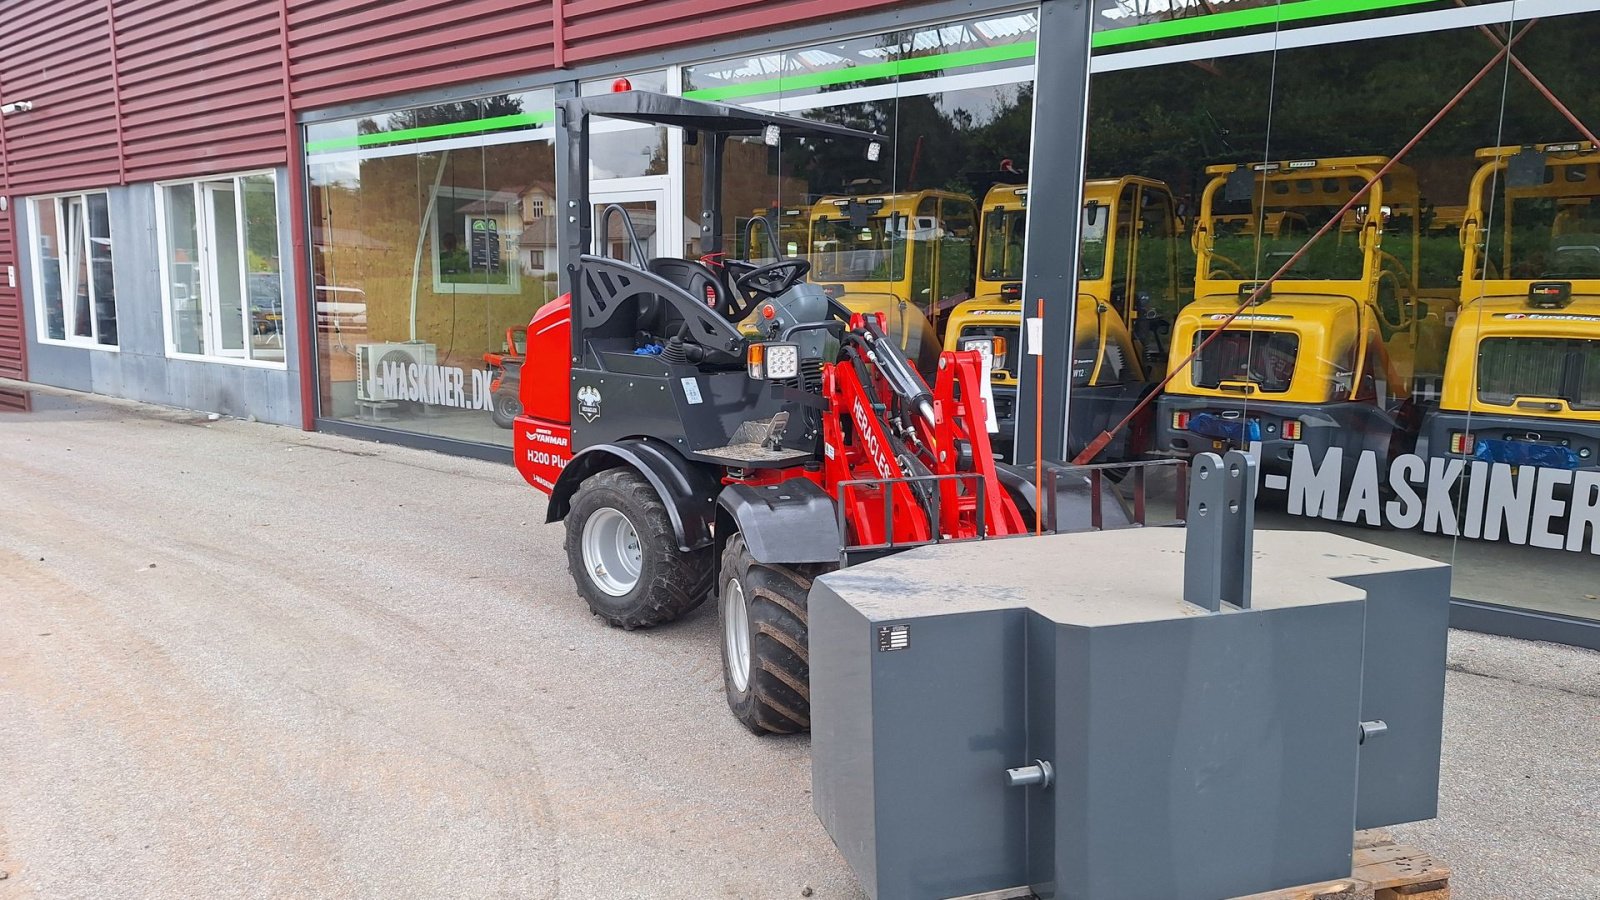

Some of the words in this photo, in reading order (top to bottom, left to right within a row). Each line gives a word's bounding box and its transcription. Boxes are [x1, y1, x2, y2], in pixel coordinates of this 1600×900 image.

[366, 360, 495, 413] J-MASKINER.DK
[536, 433, 568, 447] YANMAR
[527, 449, 550, 466] H200
